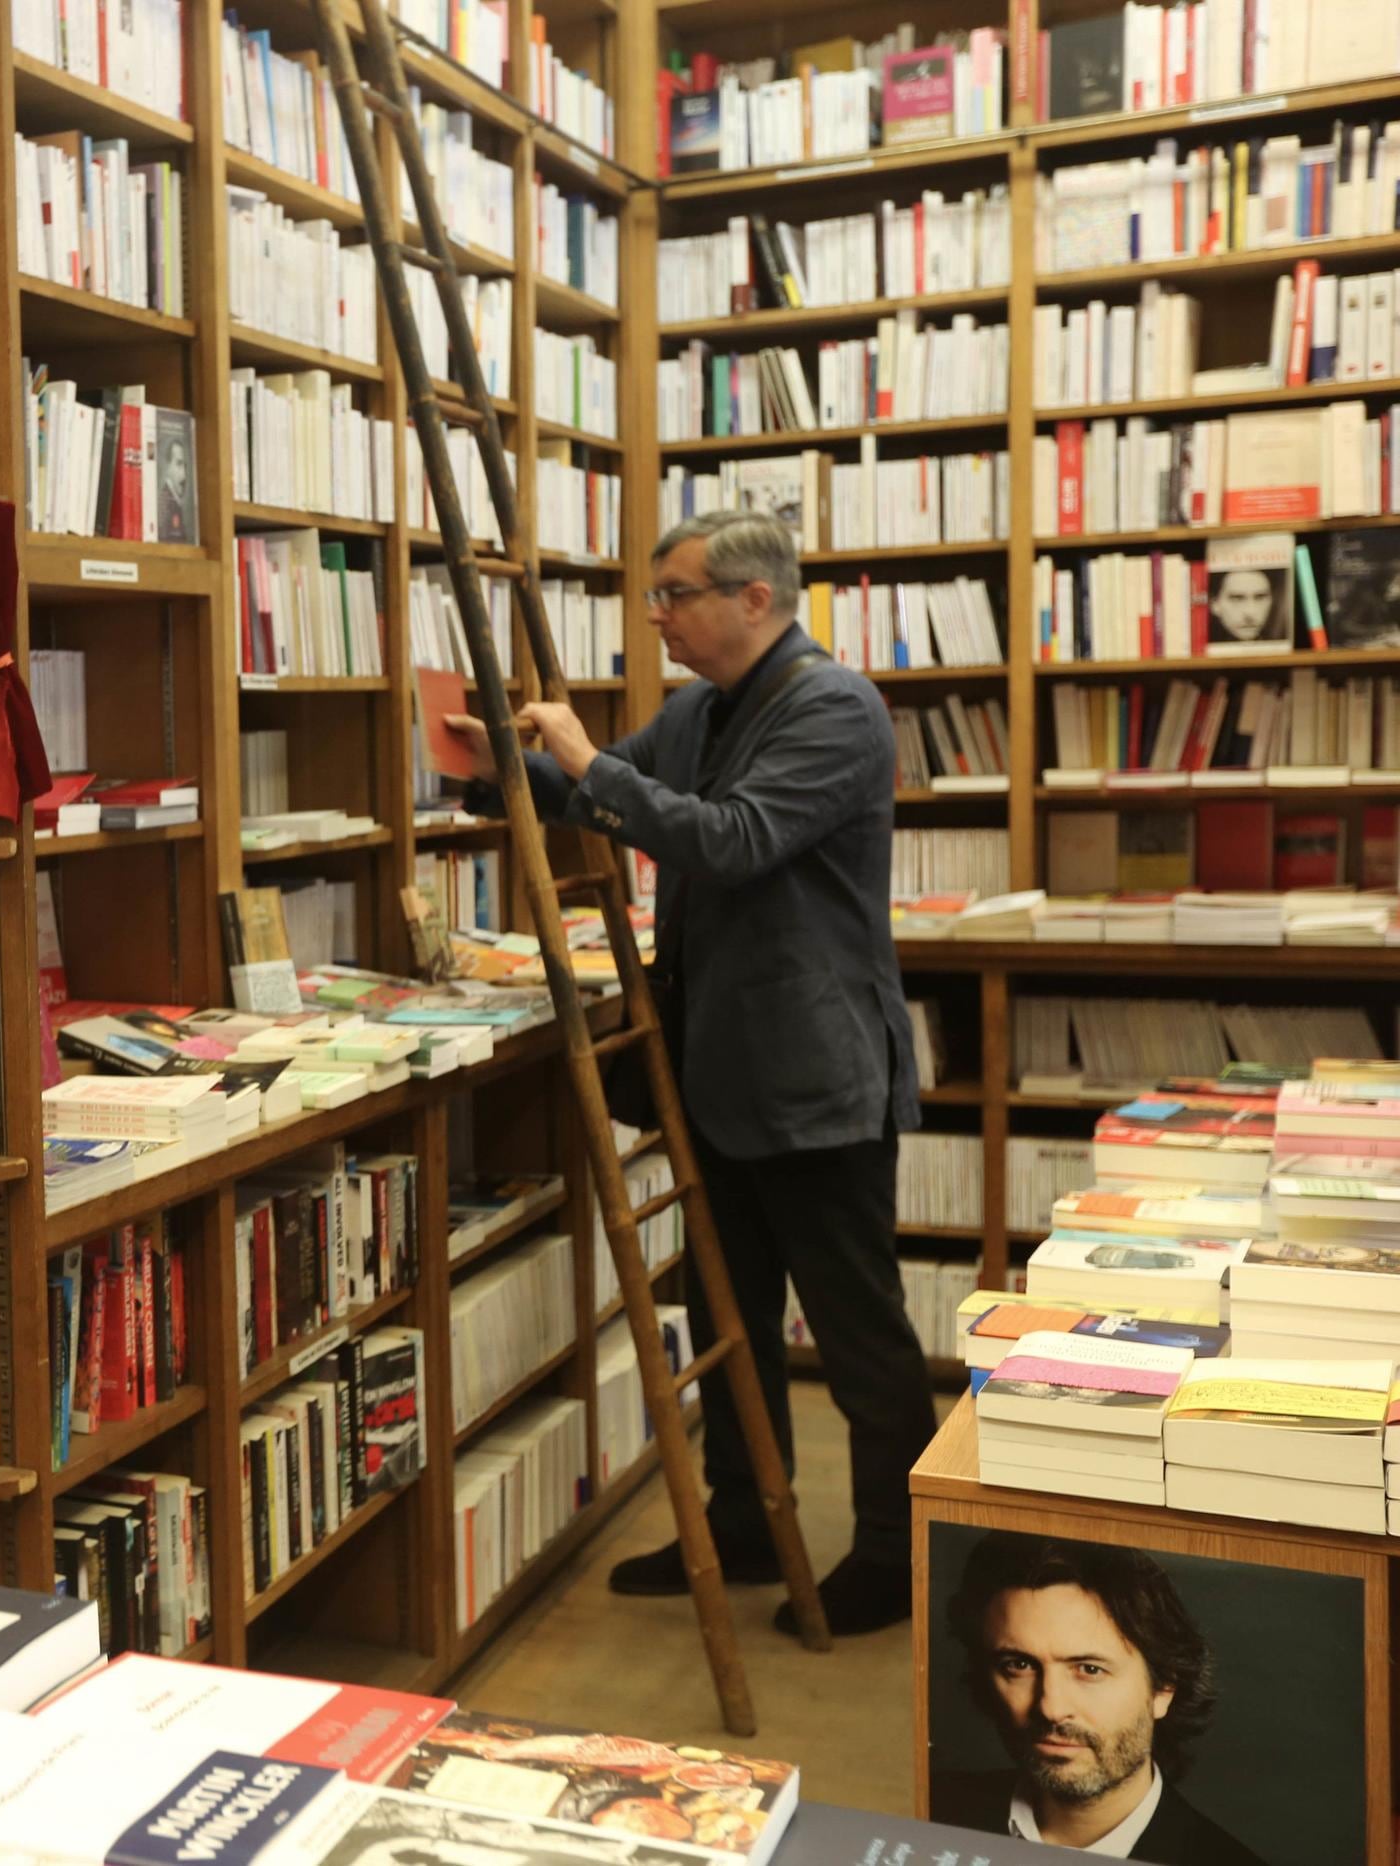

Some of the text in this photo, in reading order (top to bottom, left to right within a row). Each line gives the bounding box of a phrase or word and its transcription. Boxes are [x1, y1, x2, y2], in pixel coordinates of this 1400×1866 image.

[334, 1177, 345, 1268] ALL INVOLVED
[143, 1239, 154, 1368] HARLAN COBEN
[146, 1766, 246, 1840] MARTIN
[176, 1762, 302, 1862] WINCKLER
